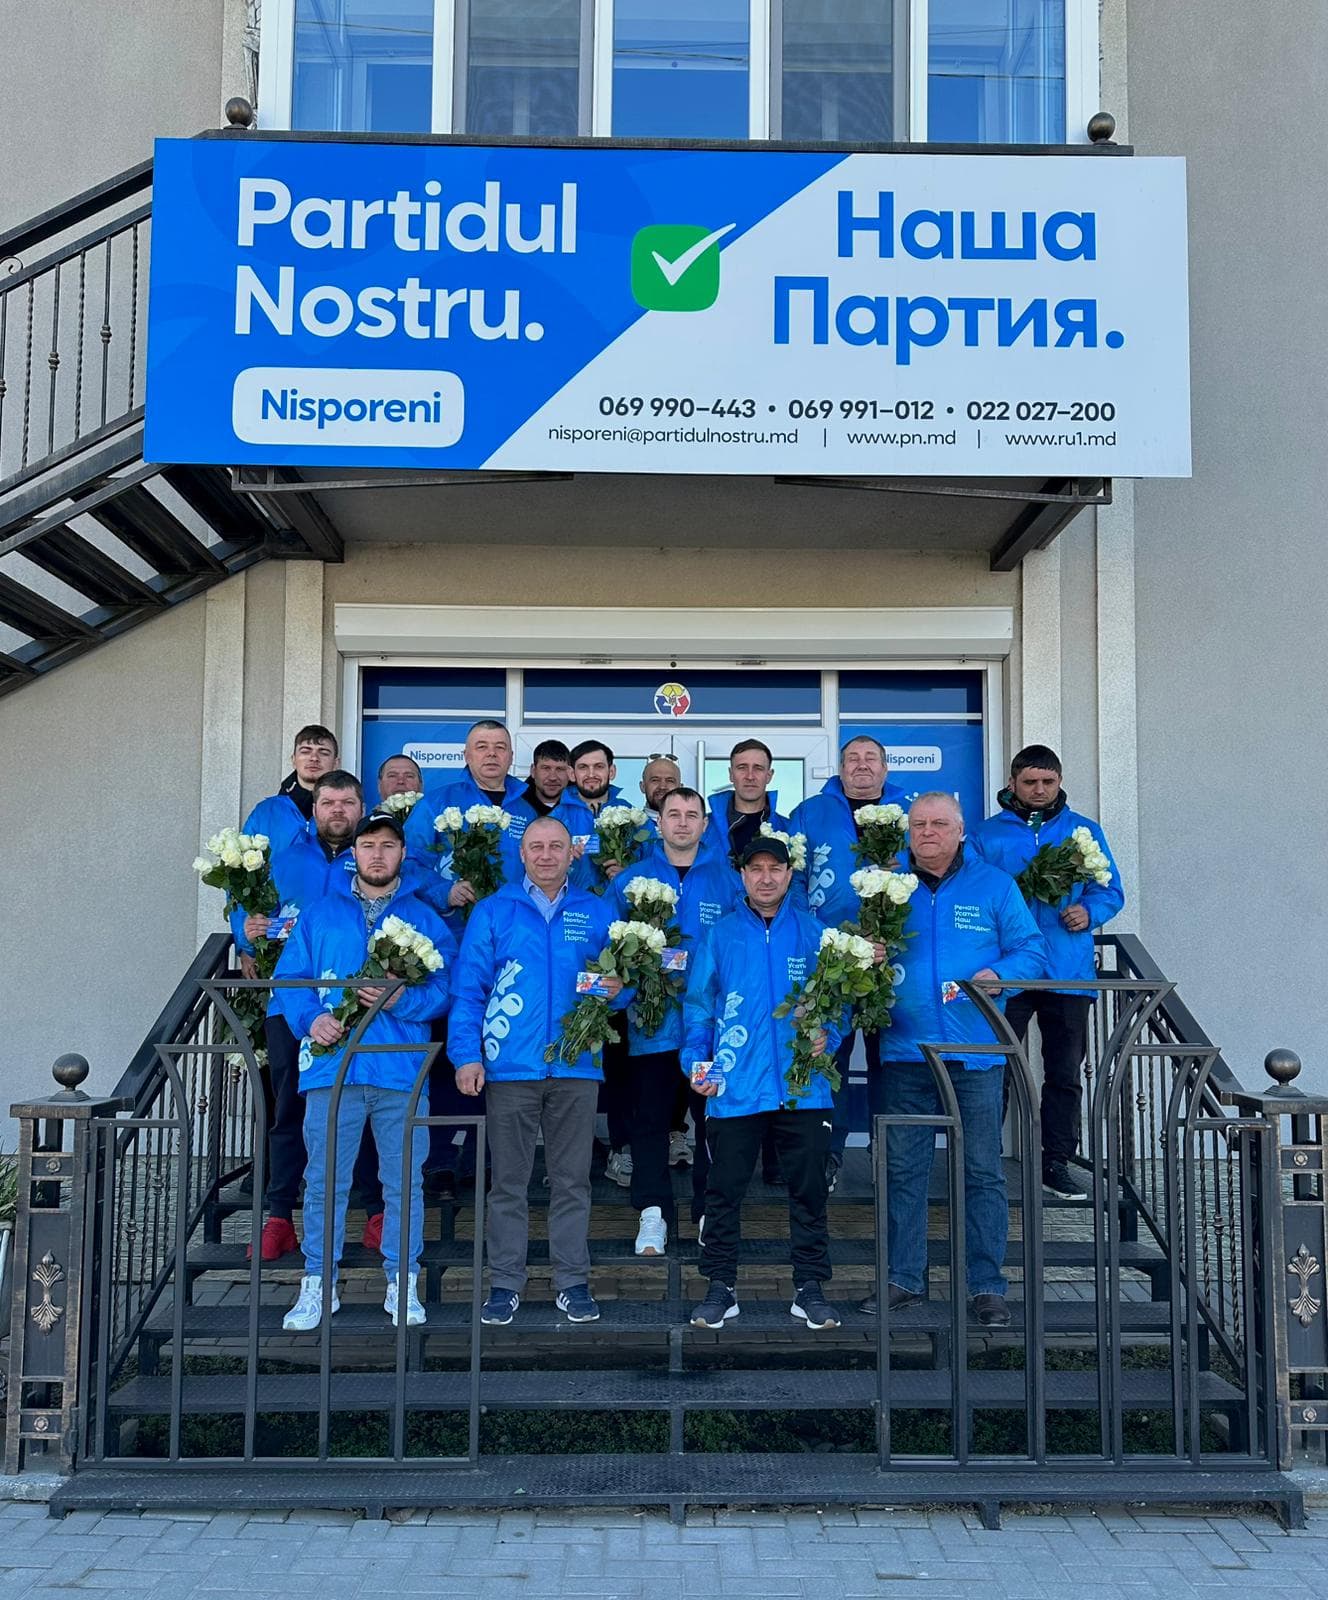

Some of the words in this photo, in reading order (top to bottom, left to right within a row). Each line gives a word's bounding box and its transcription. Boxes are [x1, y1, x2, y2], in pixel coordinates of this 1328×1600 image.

[237, 177, 577, 254] Partidul
[837, 190, 1097, 262] Наша
[234, 265, 545, 342] Nostru.
[773, 275, 1125, 366] Партия.
[261, 388, 442, 430] Nisporeni
[599, 396, 644, 417] 069
[788, 399, 834, 419] 069
[966, 401, 1011, 421] 022
[548, 427, 799, 446] nisporeni@partidulnostru.md
[846, 429, 957, 449] www.pn.md
[1004, 431, 1117, 446] www.ru1.md
[410, 750, 464, 763] Nisporeni
[562, 910, 590, 919] Partidul
